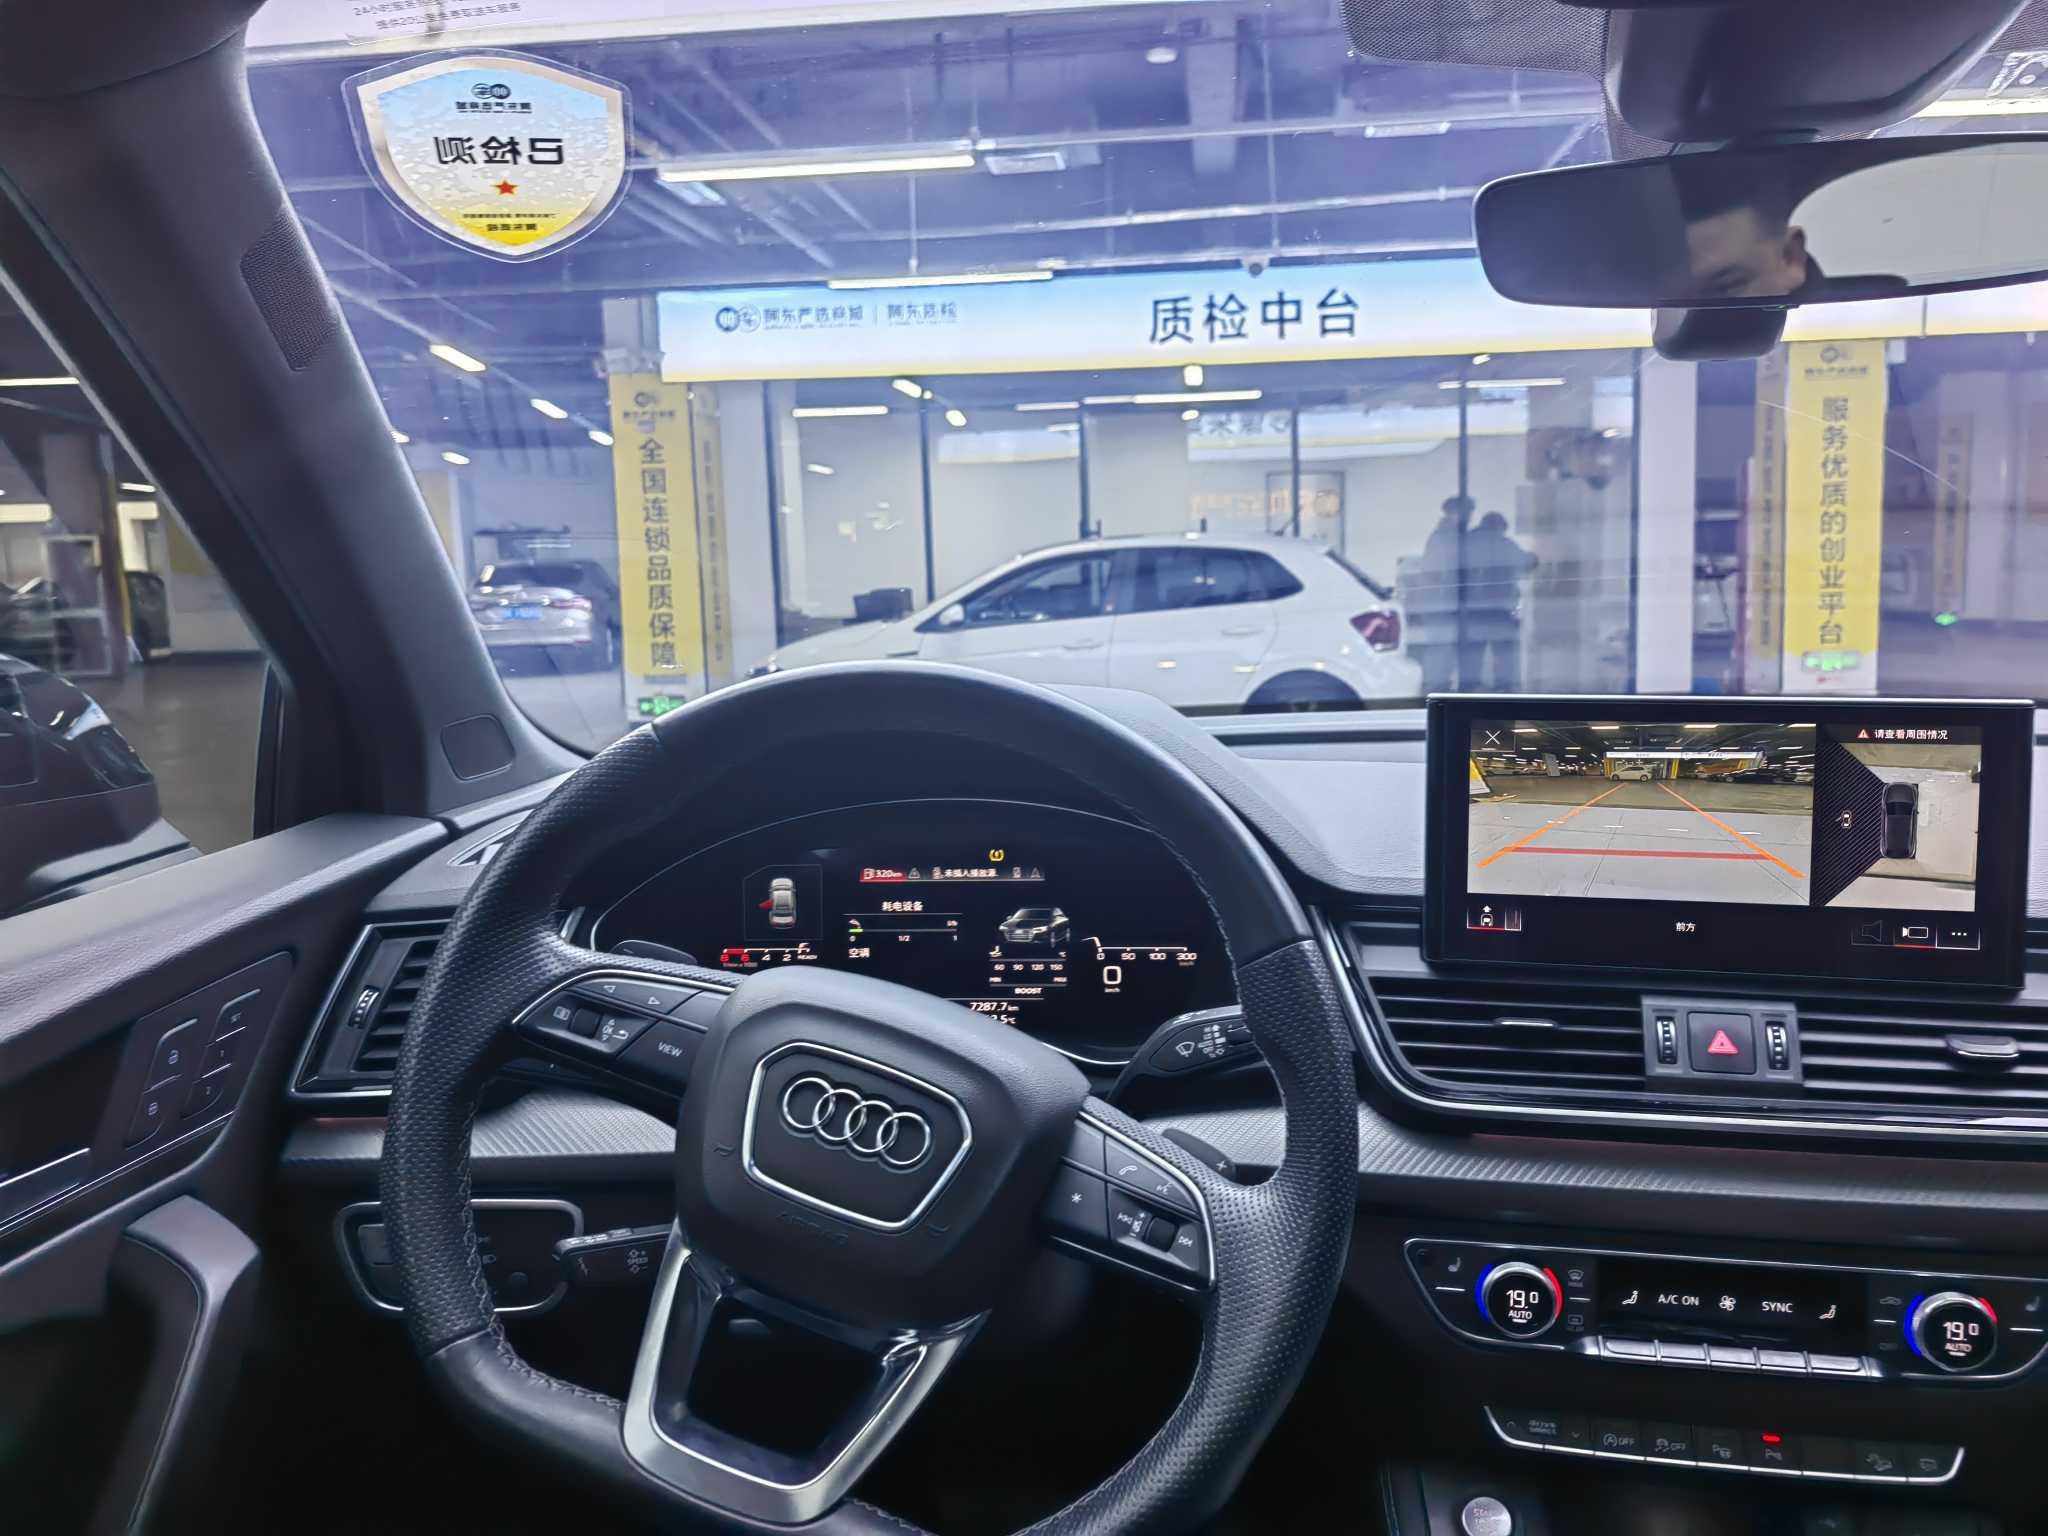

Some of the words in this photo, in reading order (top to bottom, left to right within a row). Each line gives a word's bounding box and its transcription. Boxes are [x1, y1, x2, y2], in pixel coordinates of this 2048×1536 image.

[1150, 287, 1360, 344] 质检中台
[1817, 396, 1850, 645] 服务优质的创业平台
[637, 438, 678, 669] 全国连锁品质保障
[1874, 728, 1949, 742] 请查看周围情况
[881, 901, 923, 912] 耗电设备
[1675, 921, 1697, 933] 前方
[761, 953, 771, 961] 4
[782, 953, 792, 962] 2
[848, 947, 871, 958] 空调
[1096, 952, 1106, 961] 0
[1121, 952, 1137, 961] 50
[1149, 952, 1167, 961] 100
[1176, 952, 1198, 961] 300
[1012, 963, 1025, 971] 90
[1031, 963, 1045, 971] 120
[1049, 963, 1064, 971] 150
[1103, 965, 1122, 985] 0
[1014, 987, 1043, 995] BOOST
[969, 1002, 1008, 1012] 7287.7
[657, 1041, 683, 1058] VIEW
[1658, 1293, 1679, 1305] A/C
[1681, 1295, 1700, 1307] ON
[1761, 1301, 1794, 1314] SYNC
[1508, 1309, 1533, 1320] AUTO
[1944, 1342, 1972, 1353] AUTO
[1618, 1437, 1636, 1447] OFF
